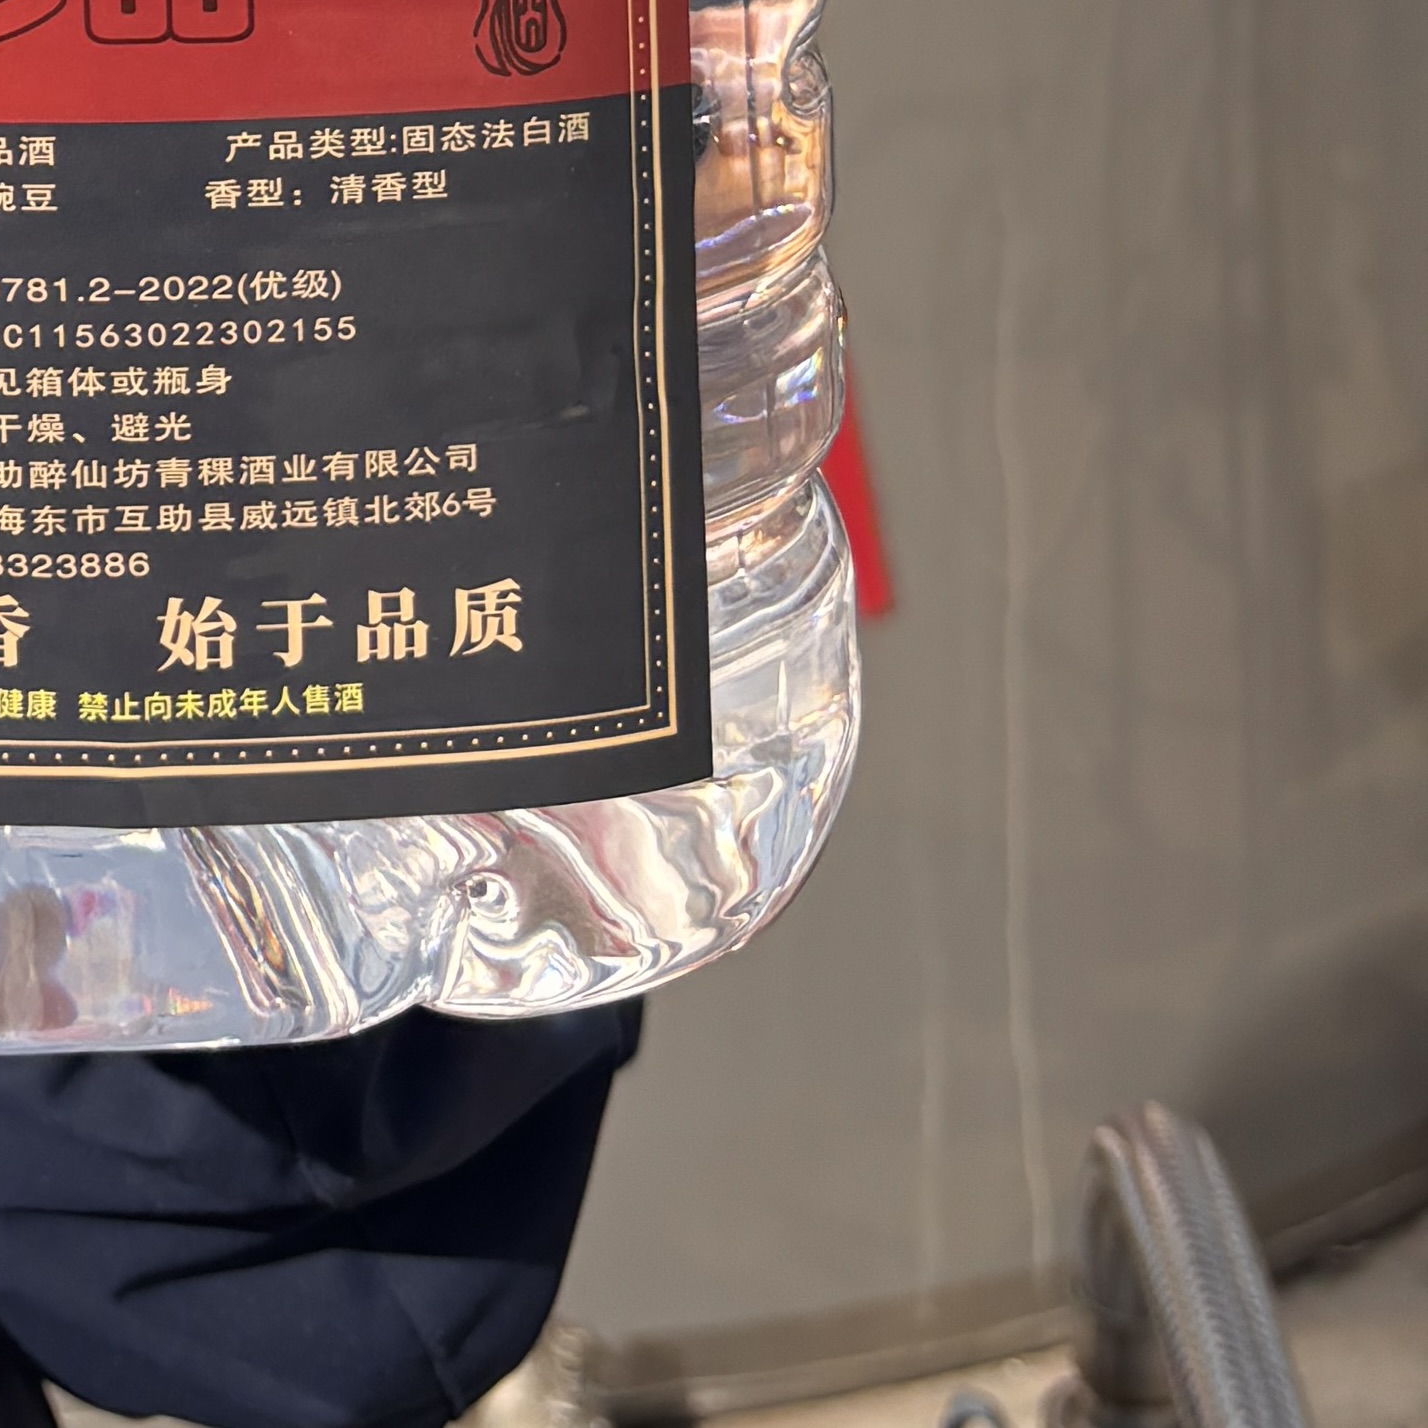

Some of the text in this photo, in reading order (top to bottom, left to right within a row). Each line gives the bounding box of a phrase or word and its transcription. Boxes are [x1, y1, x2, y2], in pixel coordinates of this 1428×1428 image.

[156, 577, 523, 672] 始于品质
[78, 680, 365, 722] 禁止向未成年人售酒
